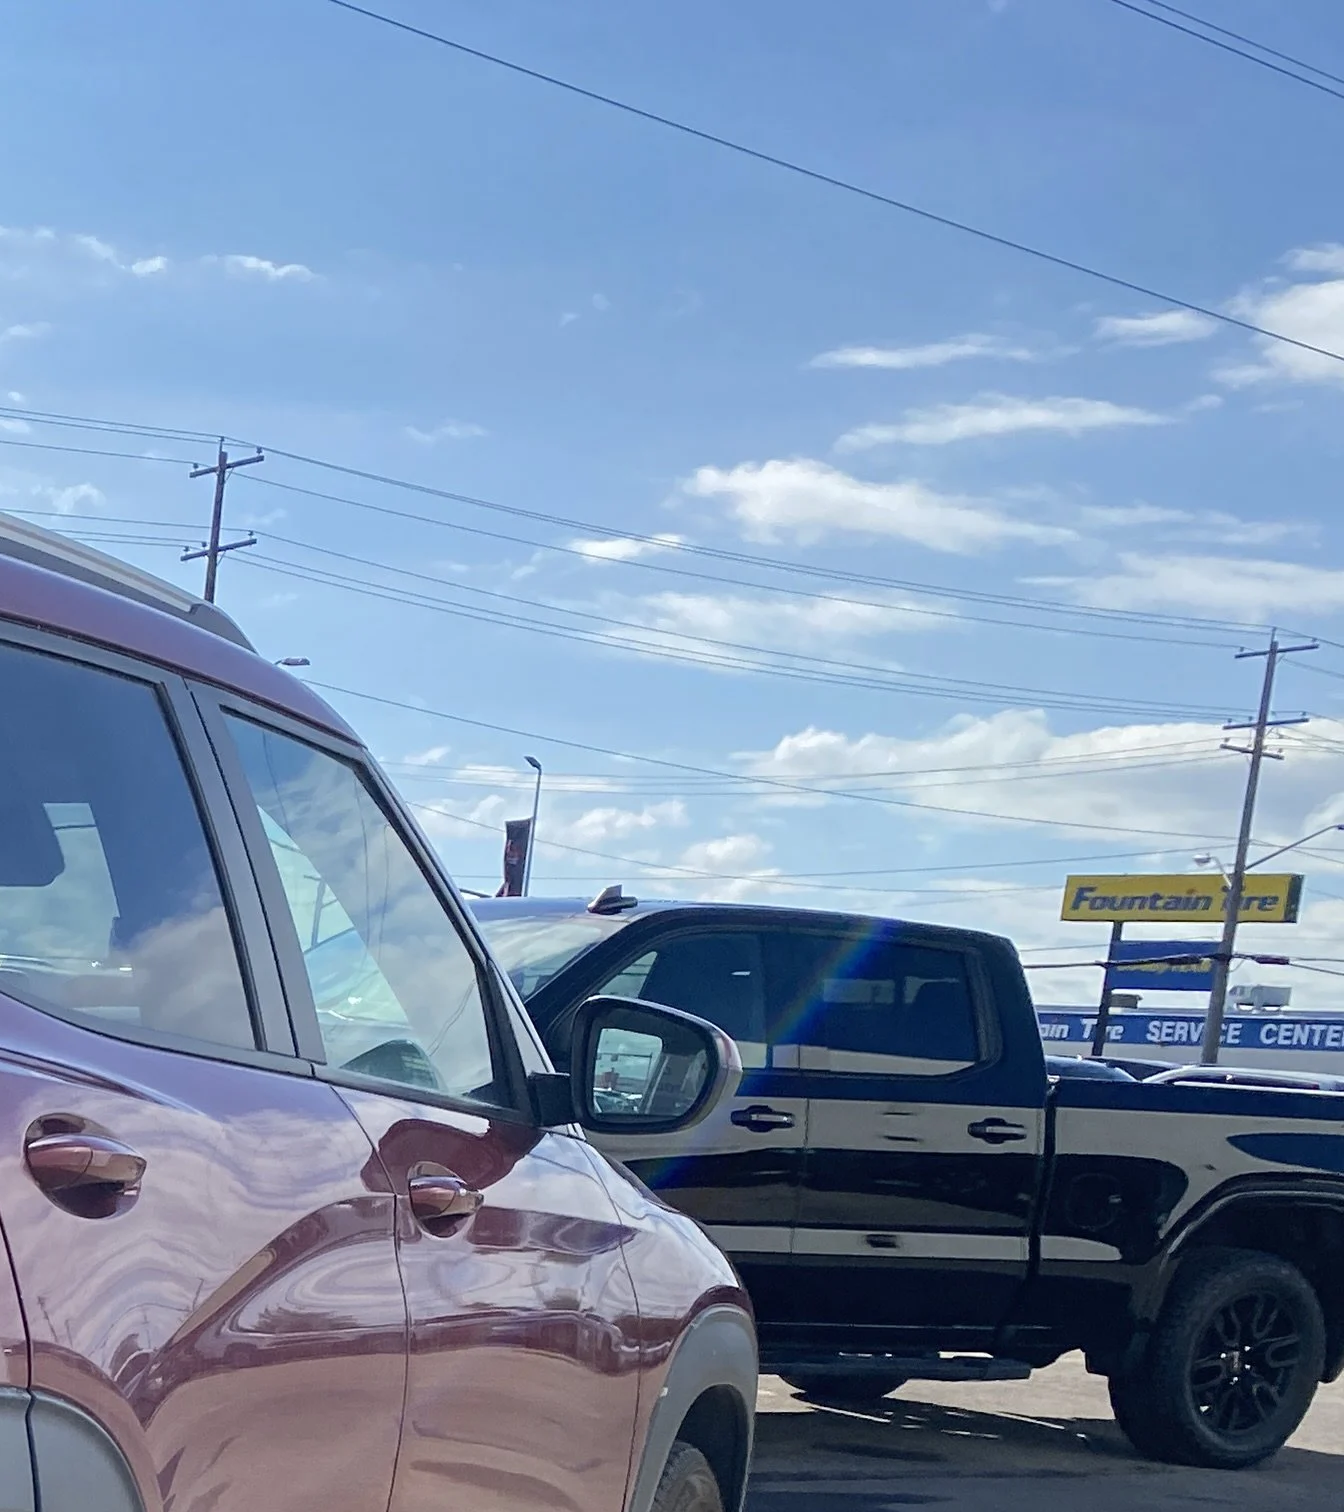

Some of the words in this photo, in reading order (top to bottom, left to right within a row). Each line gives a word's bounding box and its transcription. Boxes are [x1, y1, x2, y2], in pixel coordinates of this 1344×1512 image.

[1070, 886, 1213, 912] Fountain
[1079, 1018, 1124, 1040] Tre
[1260, 1023, 1344, 1047] CENTE
